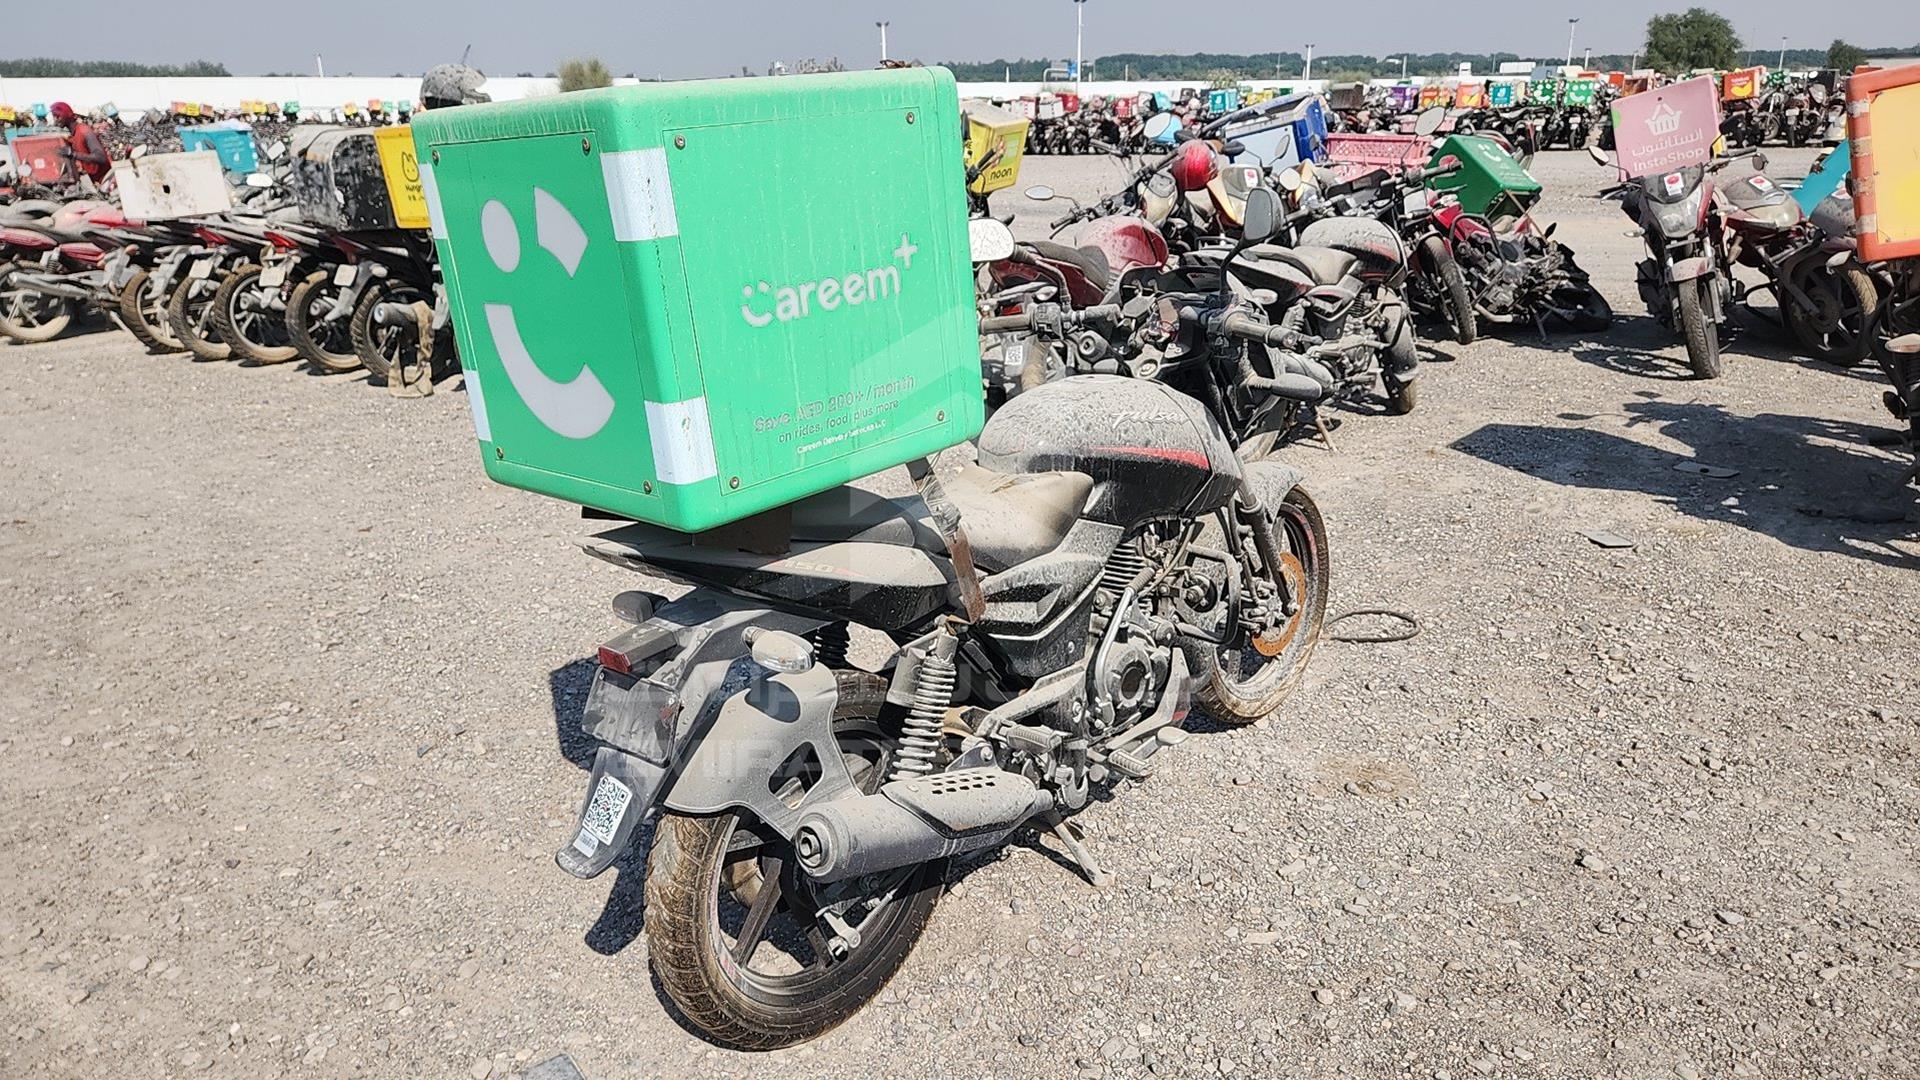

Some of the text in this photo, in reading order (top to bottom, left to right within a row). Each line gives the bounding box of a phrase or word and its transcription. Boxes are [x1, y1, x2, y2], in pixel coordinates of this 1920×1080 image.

[1632, 147, 1705, 172] InstaShop
[990, 168, 1012, 181] noon
[754, 413, 791, 432] Save
[795, 400, 824, 422] AED
[778, 431, 792, 444] on
[853, 407, 874, 423] plus
[876, 399, 900, 414] more
